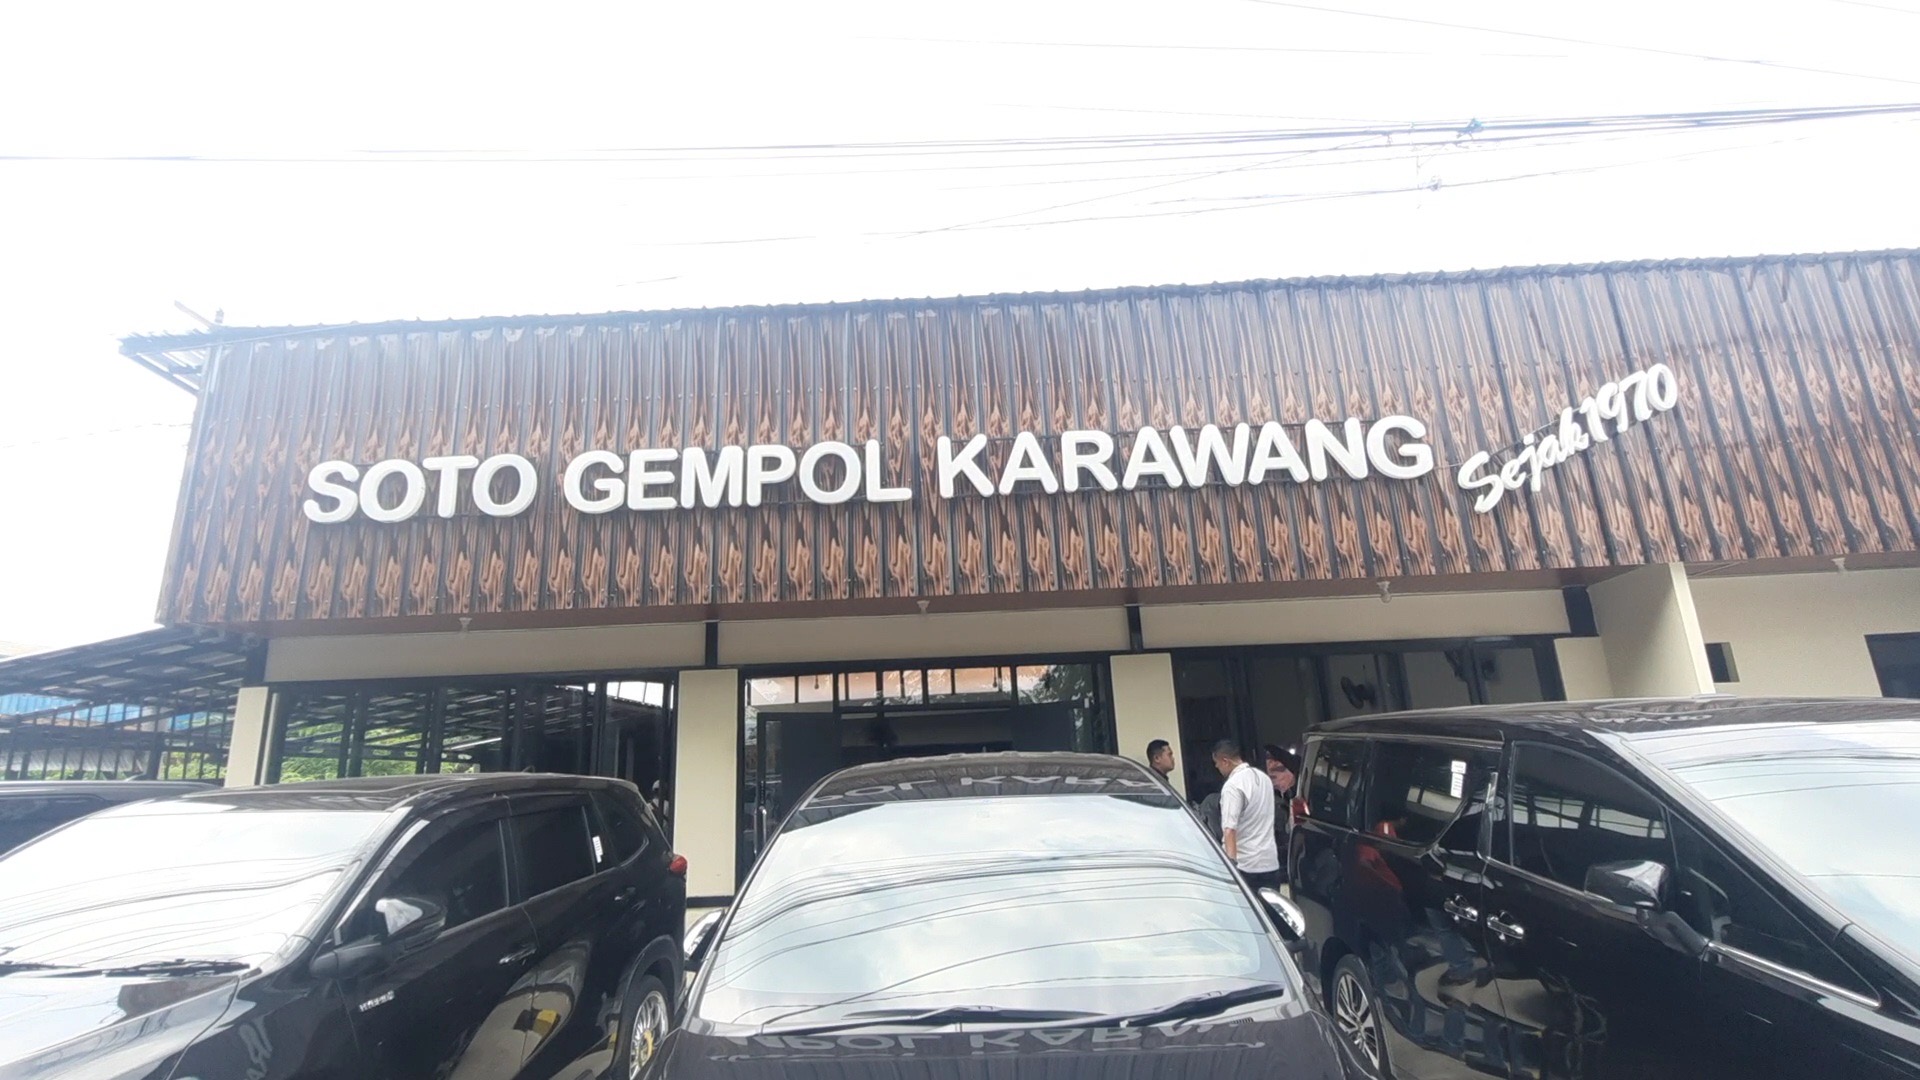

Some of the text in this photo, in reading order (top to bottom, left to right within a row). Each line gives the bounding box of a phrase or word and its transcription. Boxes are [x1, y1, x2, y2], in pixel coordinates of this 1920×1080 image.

[303, 414, 1434, 523] SOTO GEMPOL KARAWANG
